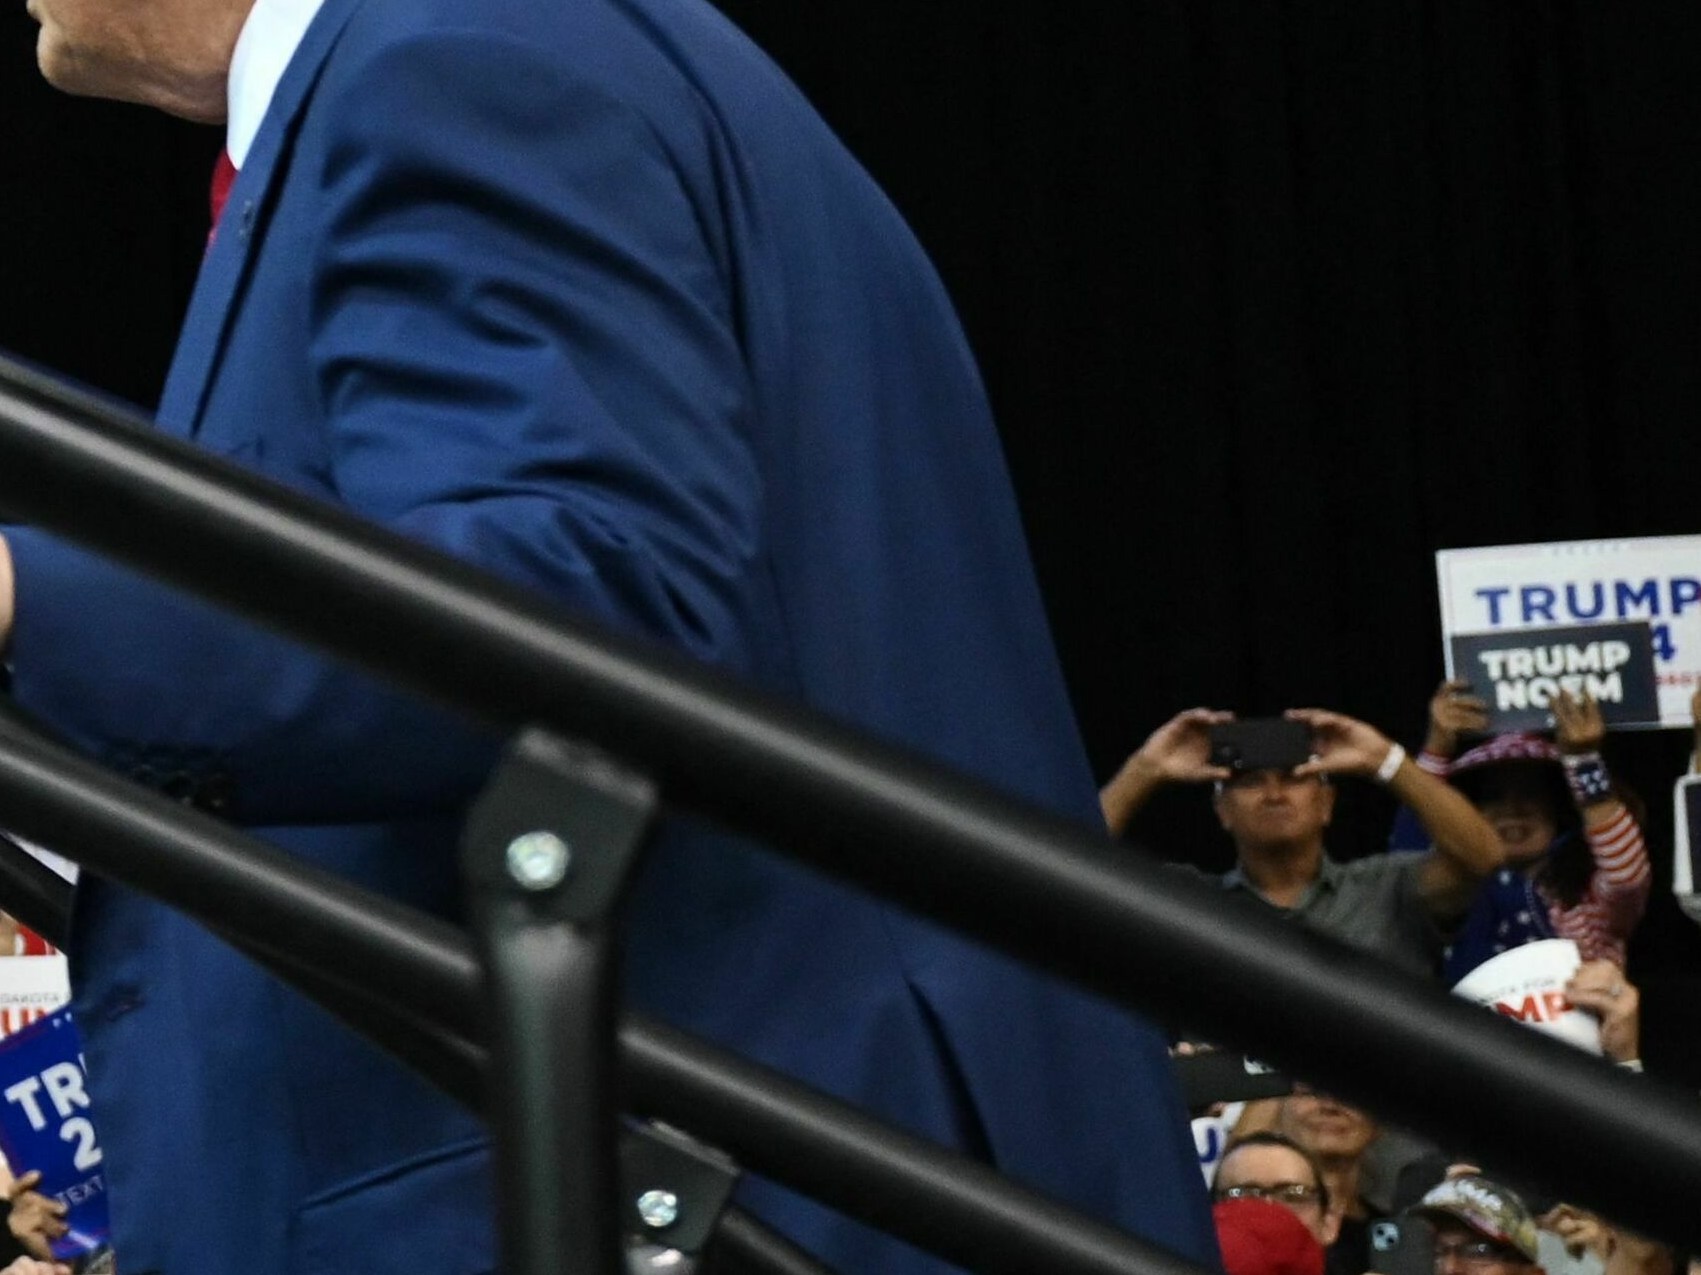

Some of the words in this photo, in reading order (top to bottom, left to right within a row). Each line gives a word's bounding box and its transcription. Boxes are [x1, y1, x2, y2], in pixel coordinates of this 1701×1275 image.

[1473, 577, 1701, 625] TRUMP
[1478, 639, 1631, 681] TRUMP
[4, 1052, 91, 1131] TR
